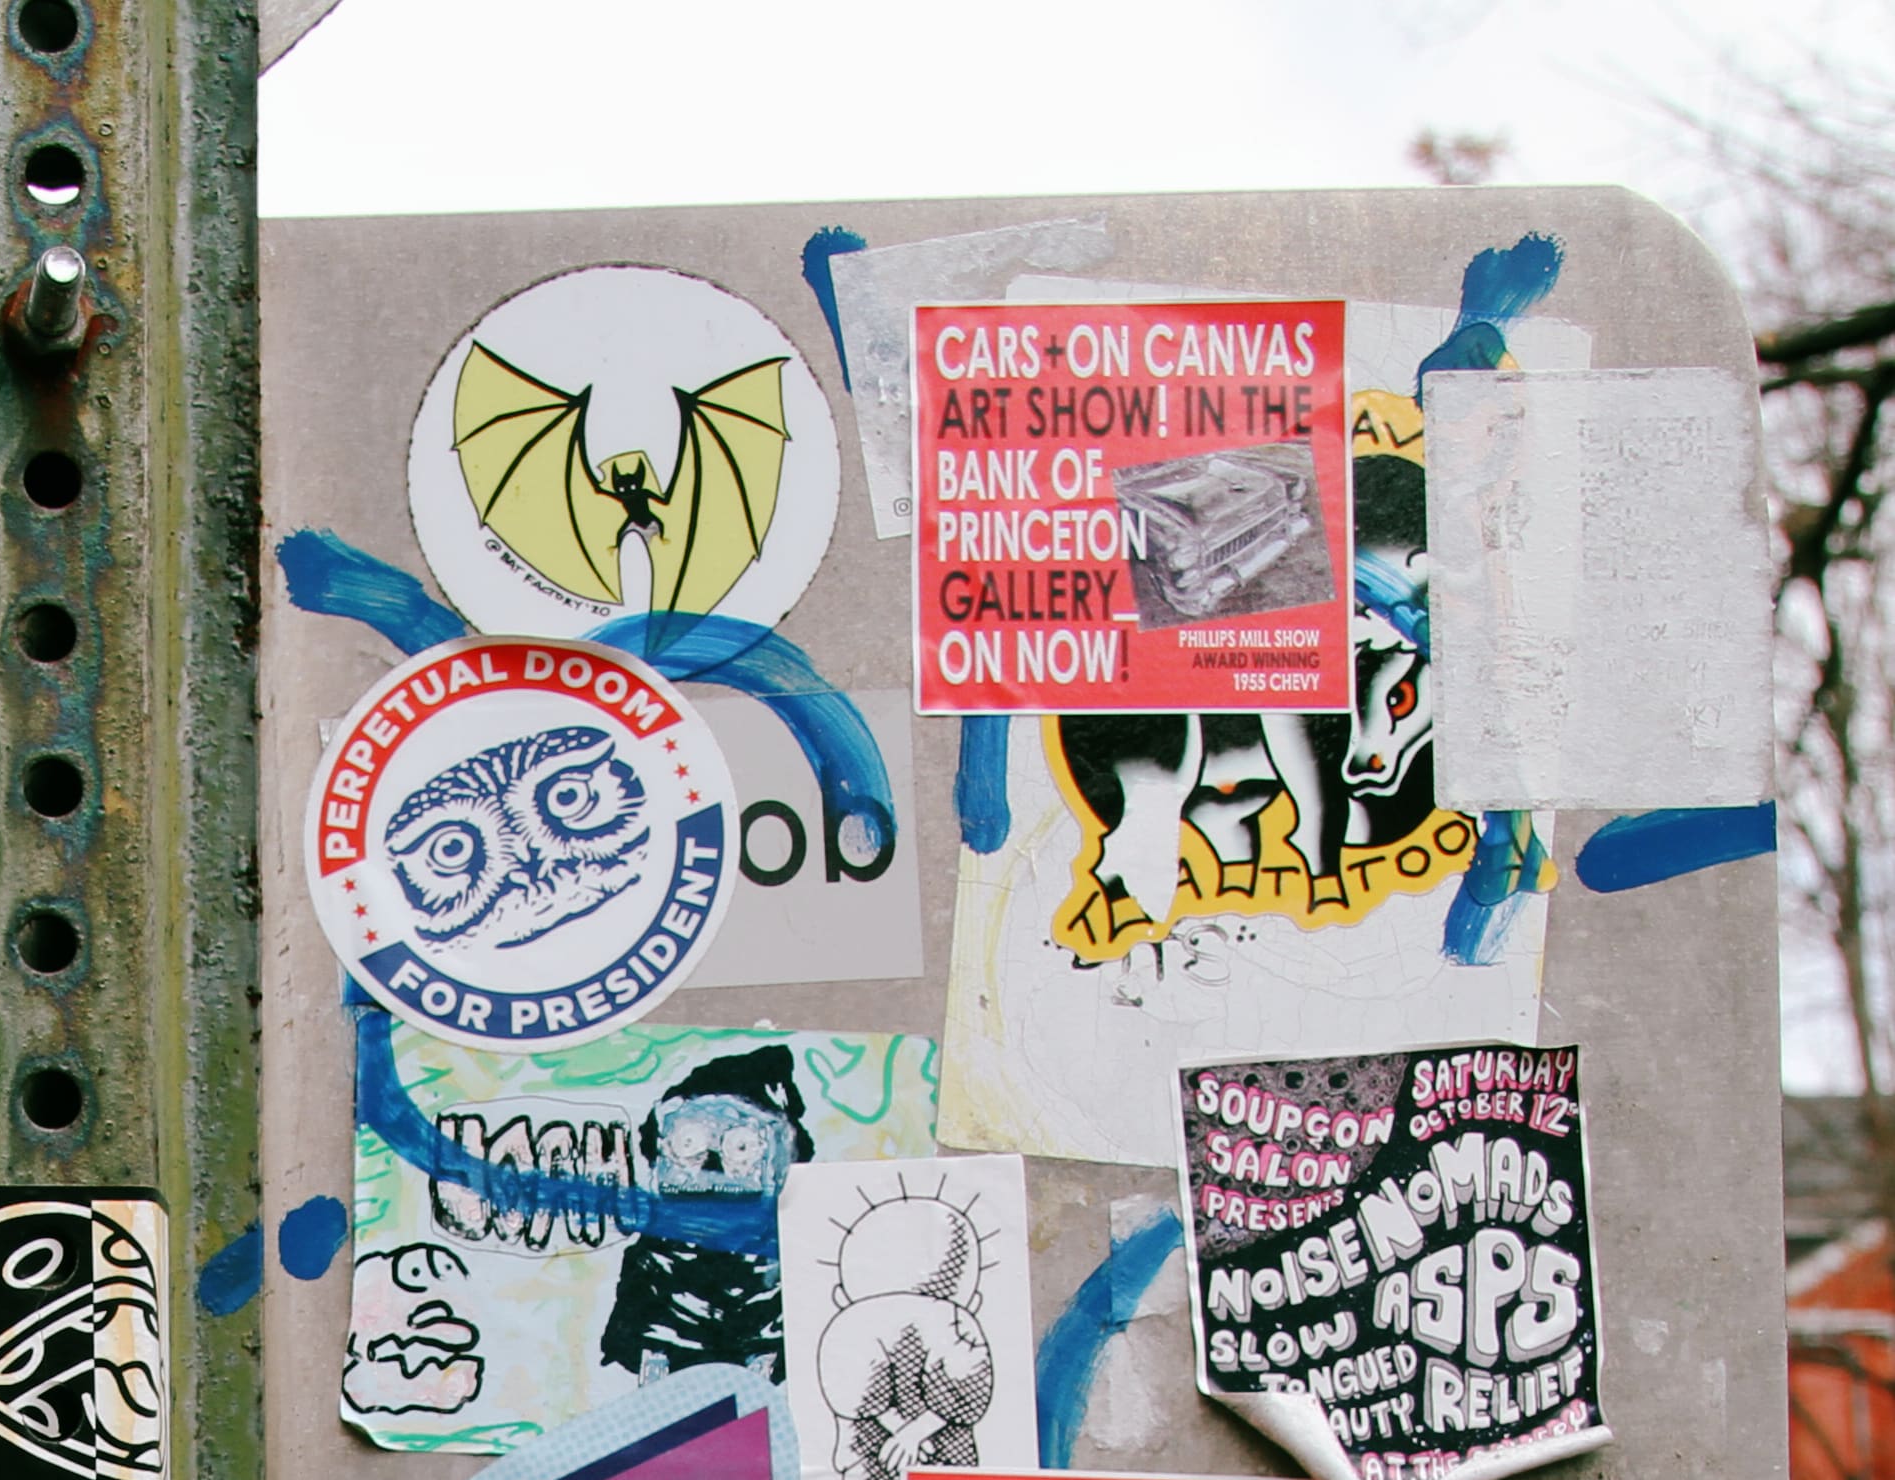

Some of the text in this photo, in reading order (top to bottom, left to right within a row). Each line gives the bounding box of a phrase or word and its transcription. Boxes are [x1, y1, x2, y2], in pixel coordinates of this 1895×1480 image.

[1144, 322, 1315, 377] CANVAS
[938, 384, 1313, 439] ART SHOW! IN THE
[937, 448, 1103, 500] BANK OF
[937, 511, 1147, 562] PRINCETON
[937, 629, 1130, 684] ON NOW!
[1178, 629, 1320, 648] PHILLIPS MILL SHOW
[1192, 651, 1320, 670] AWARD WINNING
[1233, 673, 1320, 691] 1955 CHEVY
[326, 649, 665, 859] PERPETUAL DOOM
[388, 836, 720, 1035] FOR PRESIDENT
[1412, 1050, 1575, 1107] SATURDAY
[1409, 1092, 1526, 1142] OCTOBER
[1207, 1132, 1353, 1188] SALON
[1205, 1186, 1345, 1231] PRESENTS
[1207, 1132, 1573, 1323] NOISE NOMADS
[1372, 1228, 1582, 1368] ASPS
[1209, 1310, 1358, 1372] SLOW
[1423, 1348, 1584, 1434] RELIEF
[1327, 1391, 1415, 1447] AUTY
